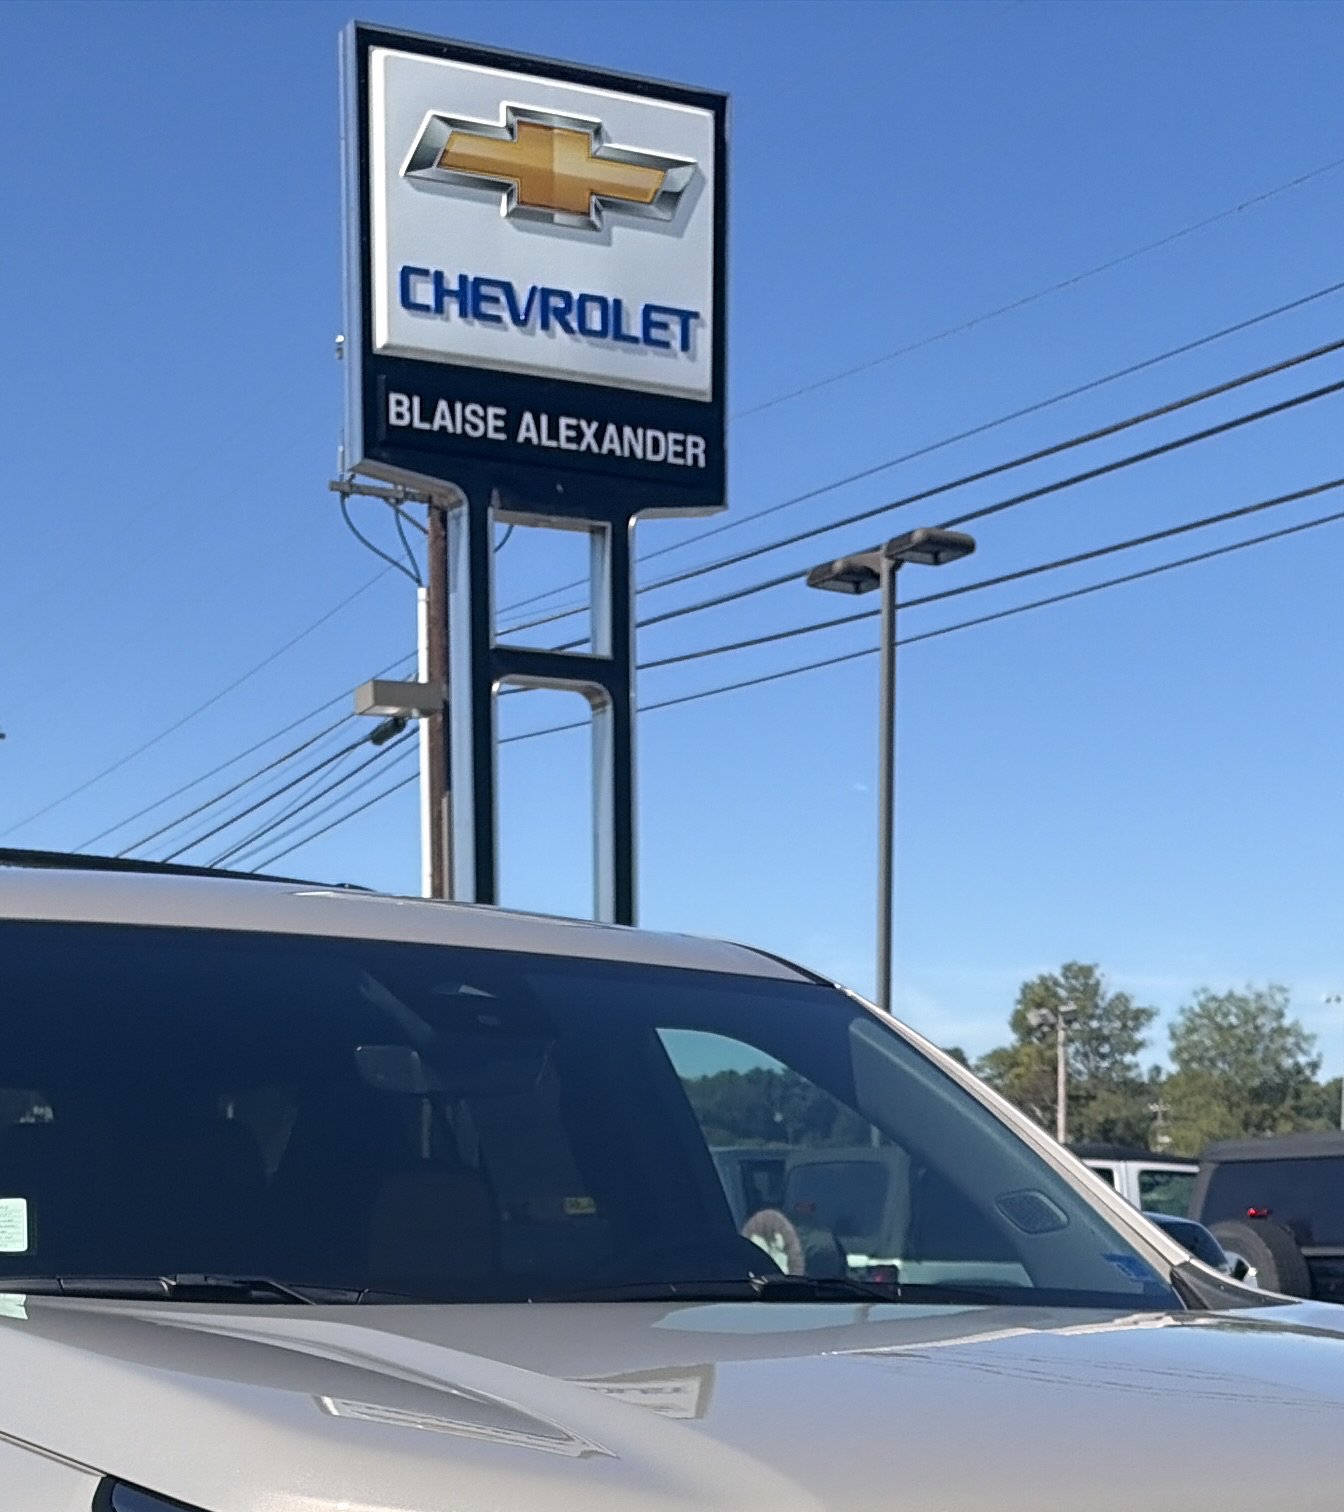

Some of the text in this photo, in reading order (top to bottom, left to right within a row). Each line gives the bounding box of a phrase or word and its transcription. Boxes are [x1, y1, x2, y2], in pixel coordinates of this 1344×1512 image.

[400, 265, 700, 353] CHEVROLET
[388, 391, 706, 469] BLAISE ALEXANDER
